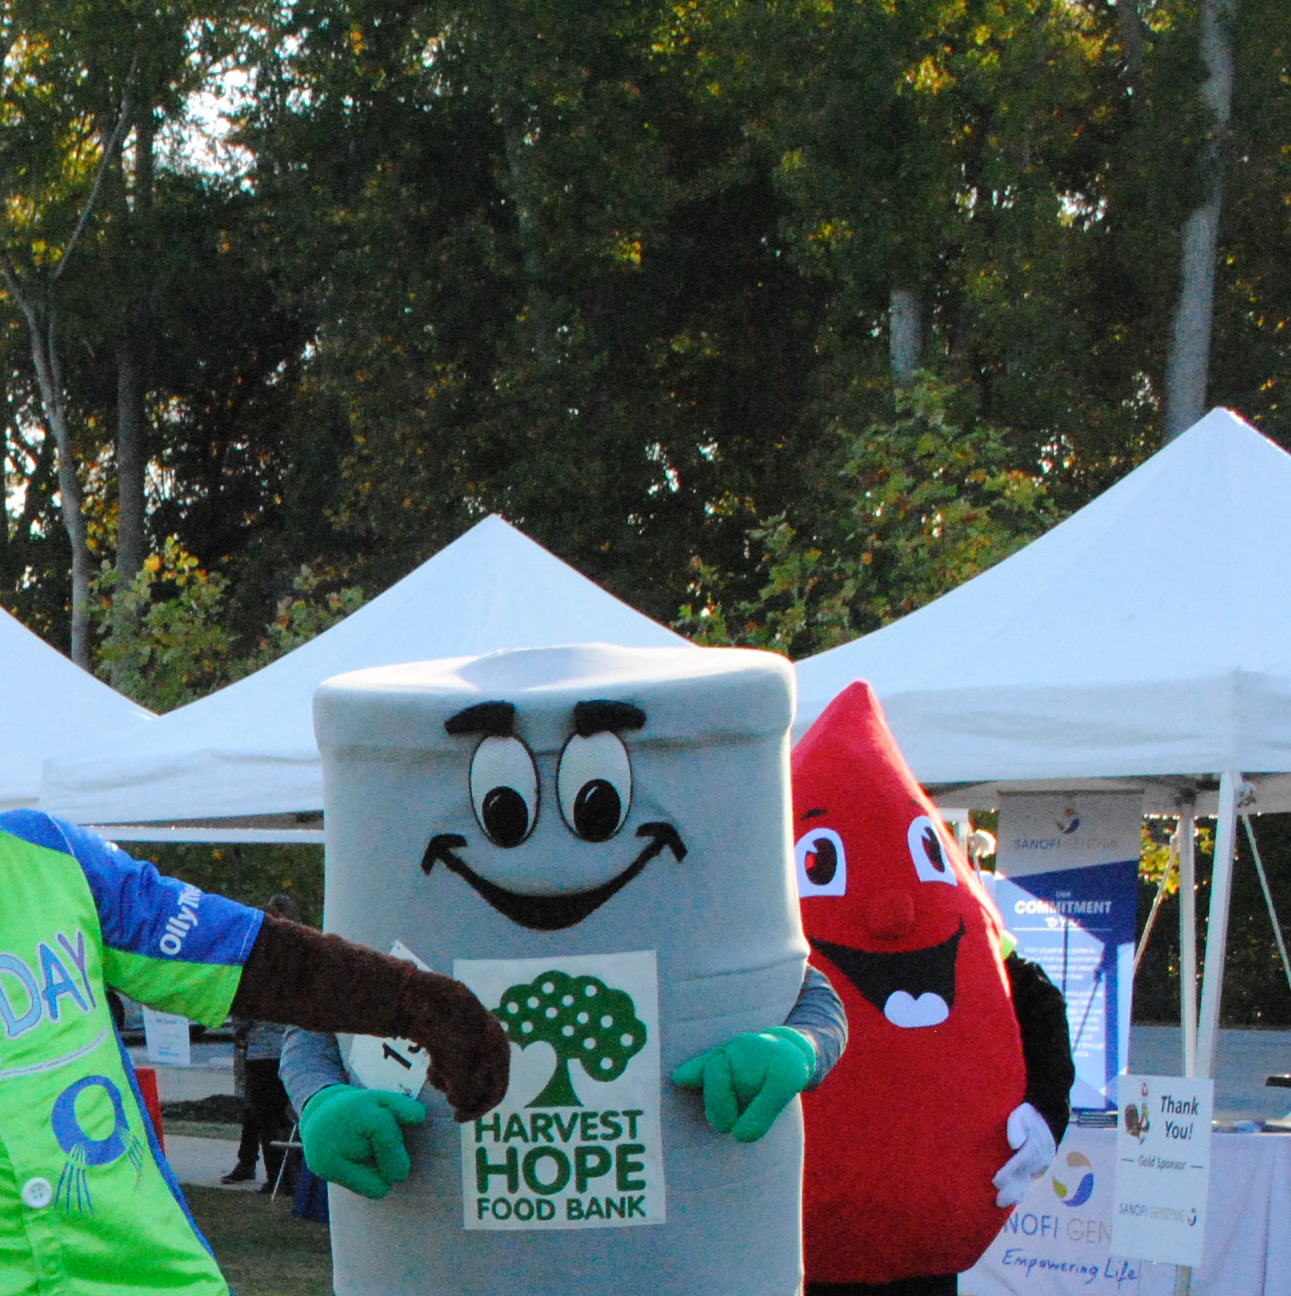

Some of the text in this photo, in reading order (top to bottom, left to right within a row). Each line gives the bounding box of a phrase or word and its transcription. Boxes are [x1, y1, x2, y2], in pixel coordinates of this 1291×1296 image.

[1014, 900, 1112, 914] COMMITMENT
[1160, 1095, 1199, 1115] Thank
[475, 1110, 644, 1142] HARVEST
[1164, 1120, 1194, 1140] You!
[476, 1144, 646, 1195] HOPE
[477, 1195, 646, 1221] FOOD BANK
[1001, 1248, 1137, 1289] Empowering Life
